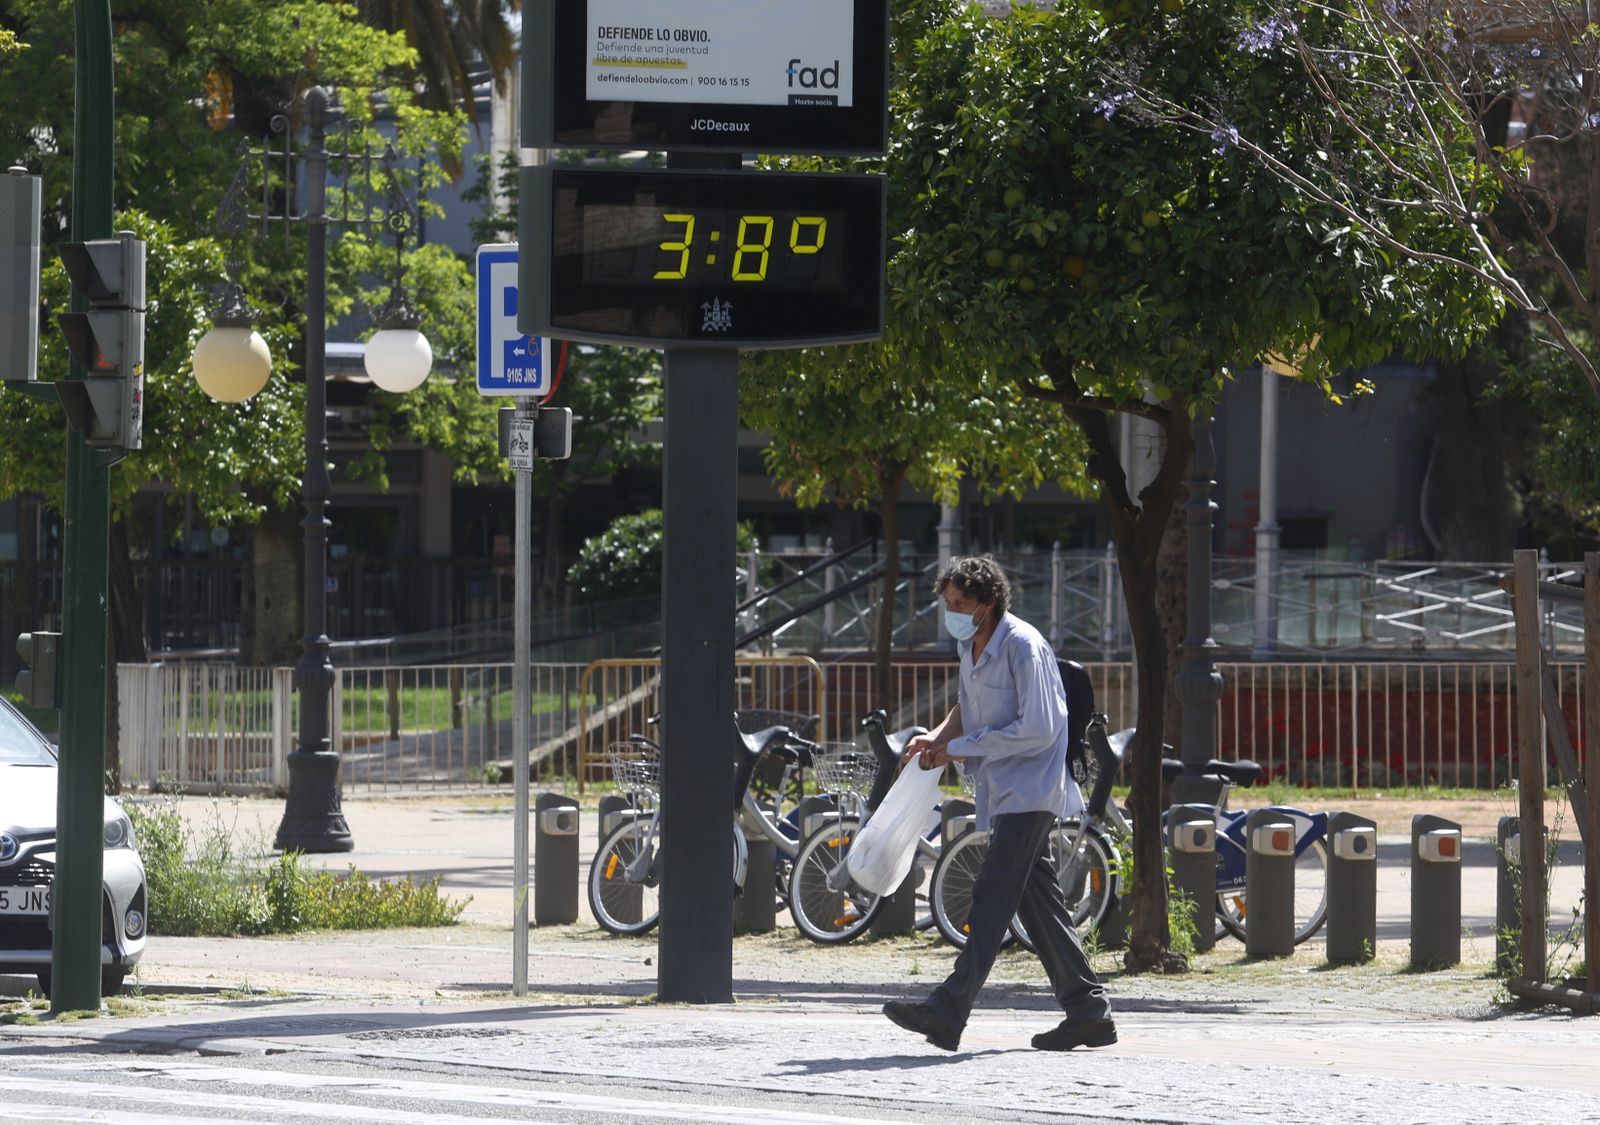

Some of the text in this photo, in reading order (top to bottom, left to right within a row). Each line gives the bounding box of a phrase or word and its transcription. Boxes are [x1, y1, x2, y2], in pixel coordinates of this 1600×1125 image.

[598, 26, 711, 43] DEFIENDE LO OBVIO.
[597, 41, 709, 55] Defiende una juventud
[596, 53, 685, 67] libre de apuestas.
[597, 72, 750, 87] defiendeloobvio.com 900 16 15 15
[786, 59, 839, 89] fad
[690, 118, 750, 132] JCDecaux
[490, 262, 526, 378] P
[507, 367, 537, 383] 9105 JNS
